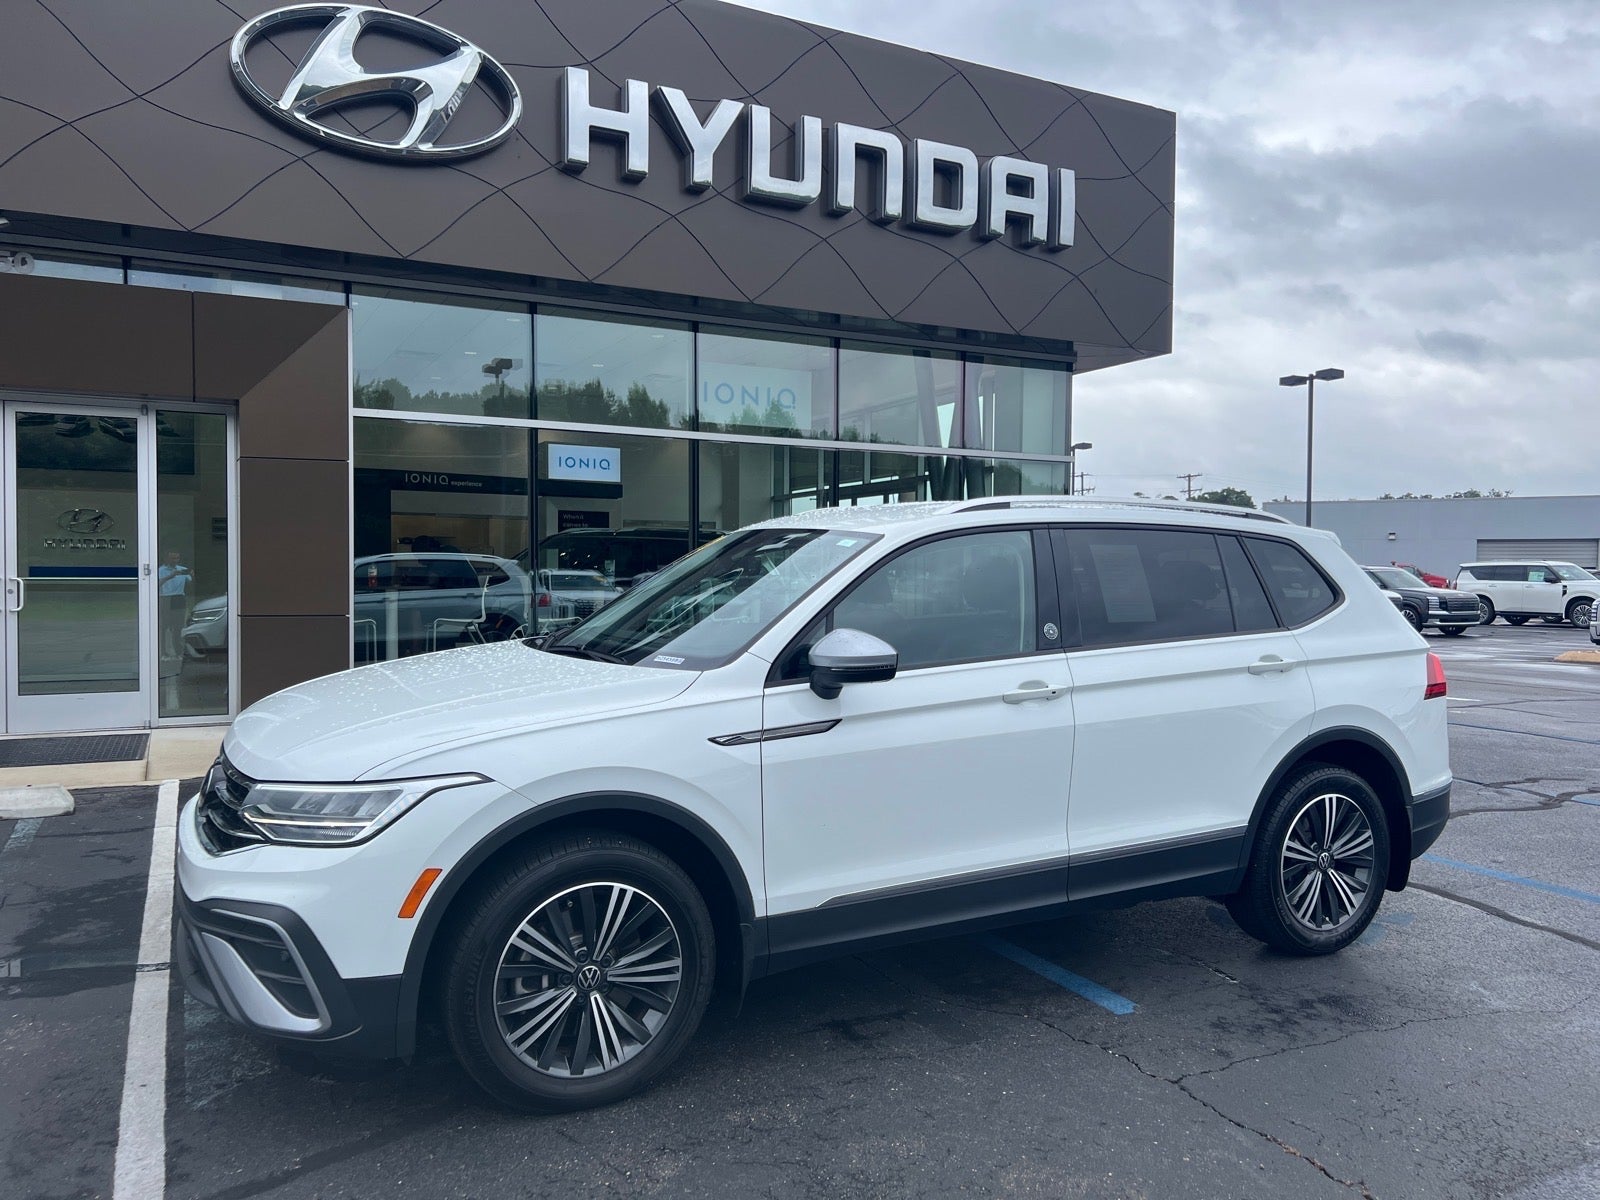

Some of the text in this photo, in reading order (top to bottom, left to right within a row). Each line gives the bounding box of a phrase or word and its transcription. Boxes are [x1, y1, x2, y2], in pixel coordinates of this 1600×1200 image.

[561, 65, 1076, 250] HYUNDAI
[703, 381, 796, 410] IONIQ
[558, 456, 611, 471] IONIQ
[405, 472, 449, 486] IONIQ
